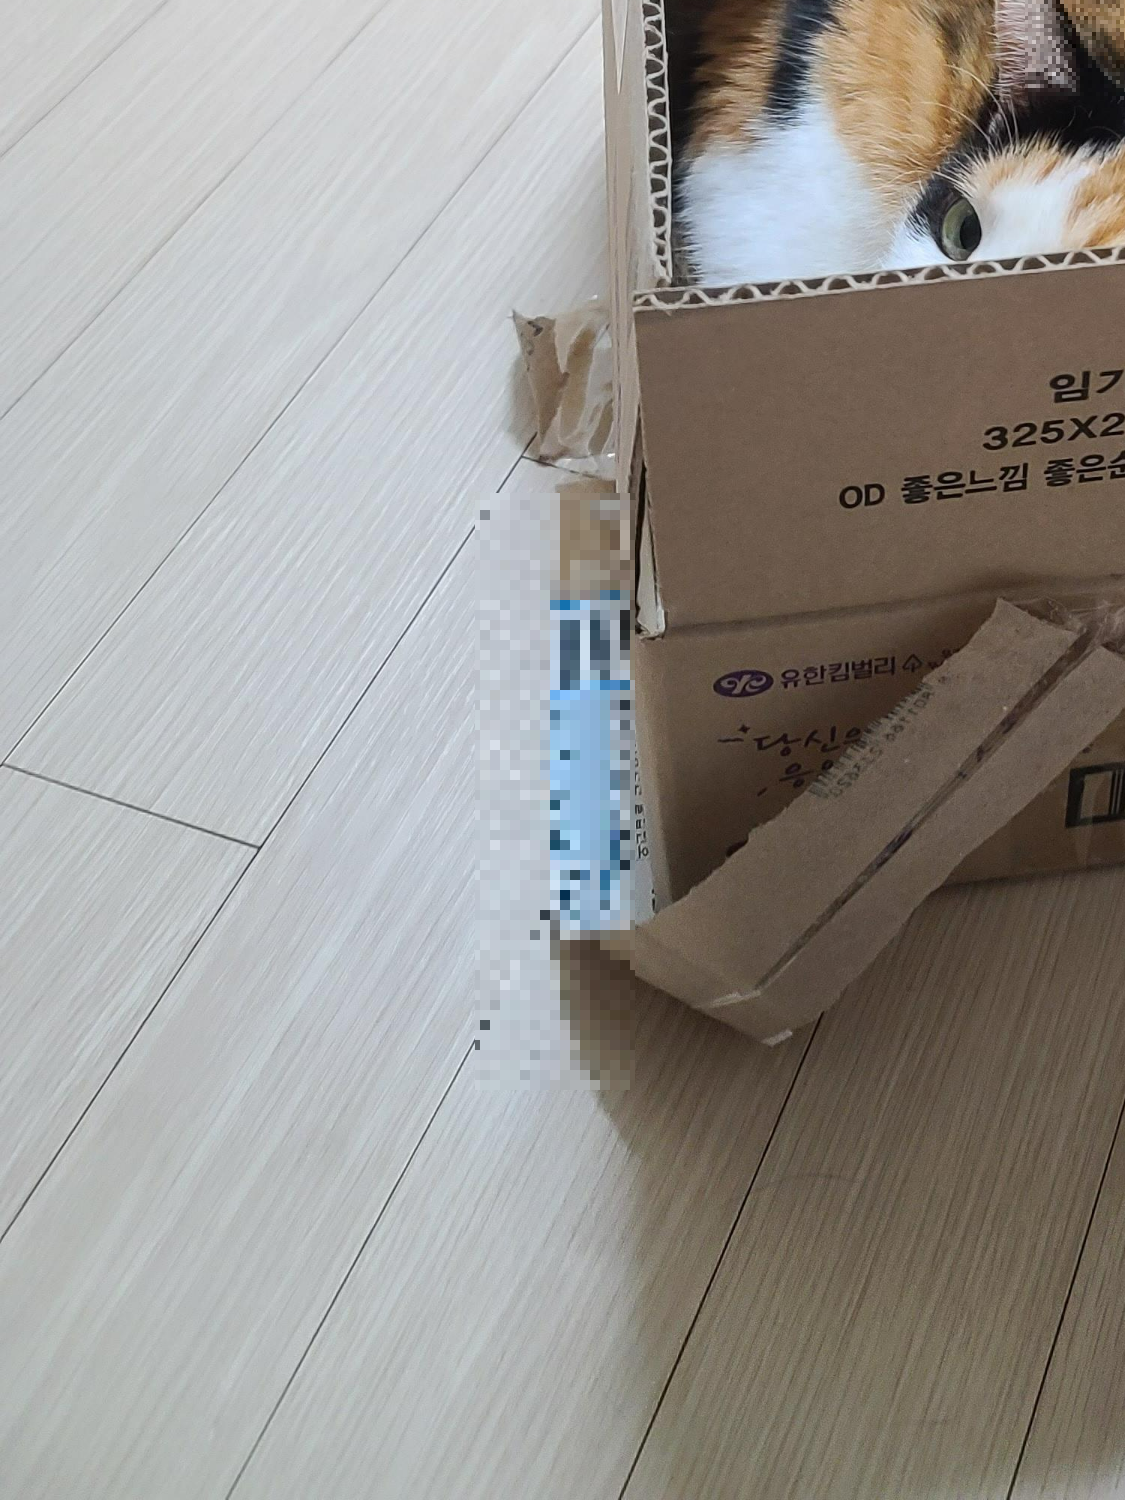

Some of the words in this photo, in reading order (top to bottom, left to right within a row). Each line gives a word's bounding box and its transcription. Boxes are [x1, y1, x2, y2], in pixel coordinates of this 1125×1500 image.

[839, 483, 886, 509] OD
[901, 463, 1029, 504] 좋은느낌
[780, 656, 896, 689] 유한킴벌리
